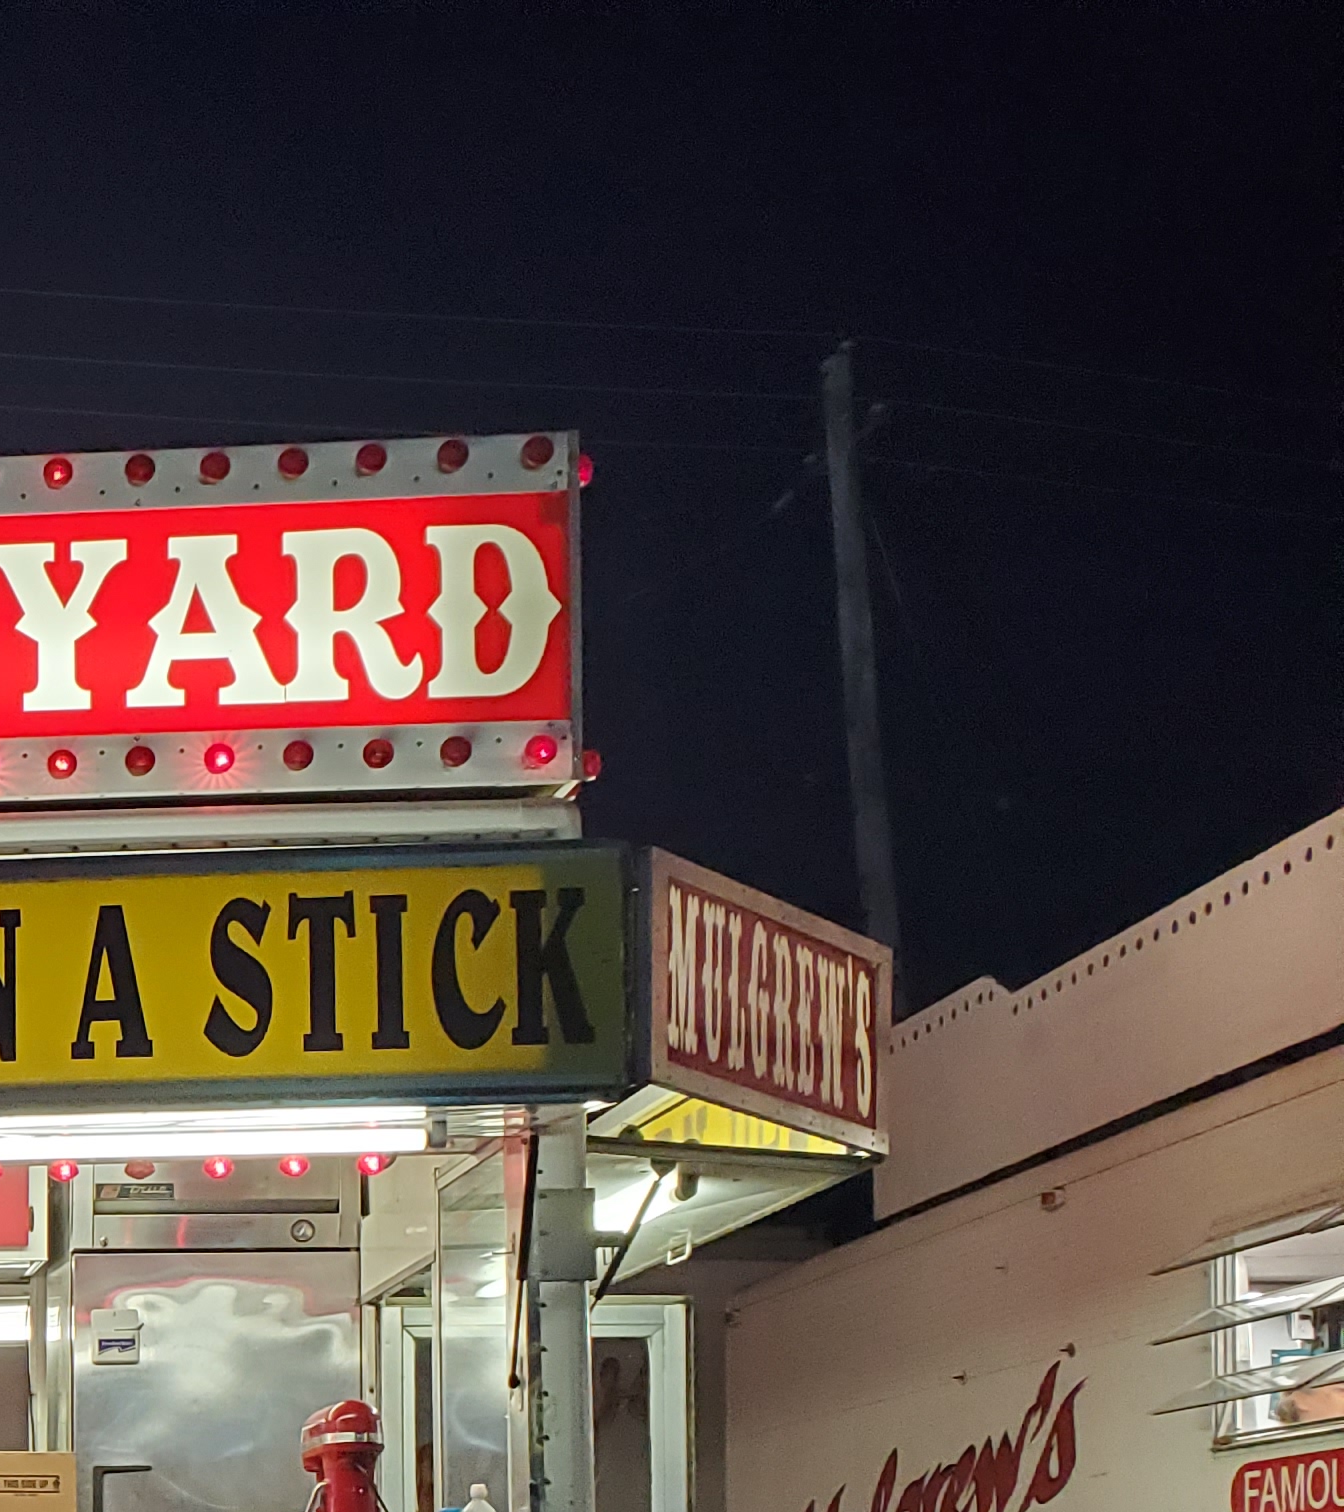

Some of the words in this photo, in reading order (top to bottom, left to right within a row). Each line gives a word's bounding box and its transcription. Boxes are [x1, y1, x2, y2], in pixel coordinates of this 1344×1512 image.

[71, 905, 153, 1060] A
[204, 887, 595, 1059] STICK
[667, 884, 873, 1120] MULGREW'S
